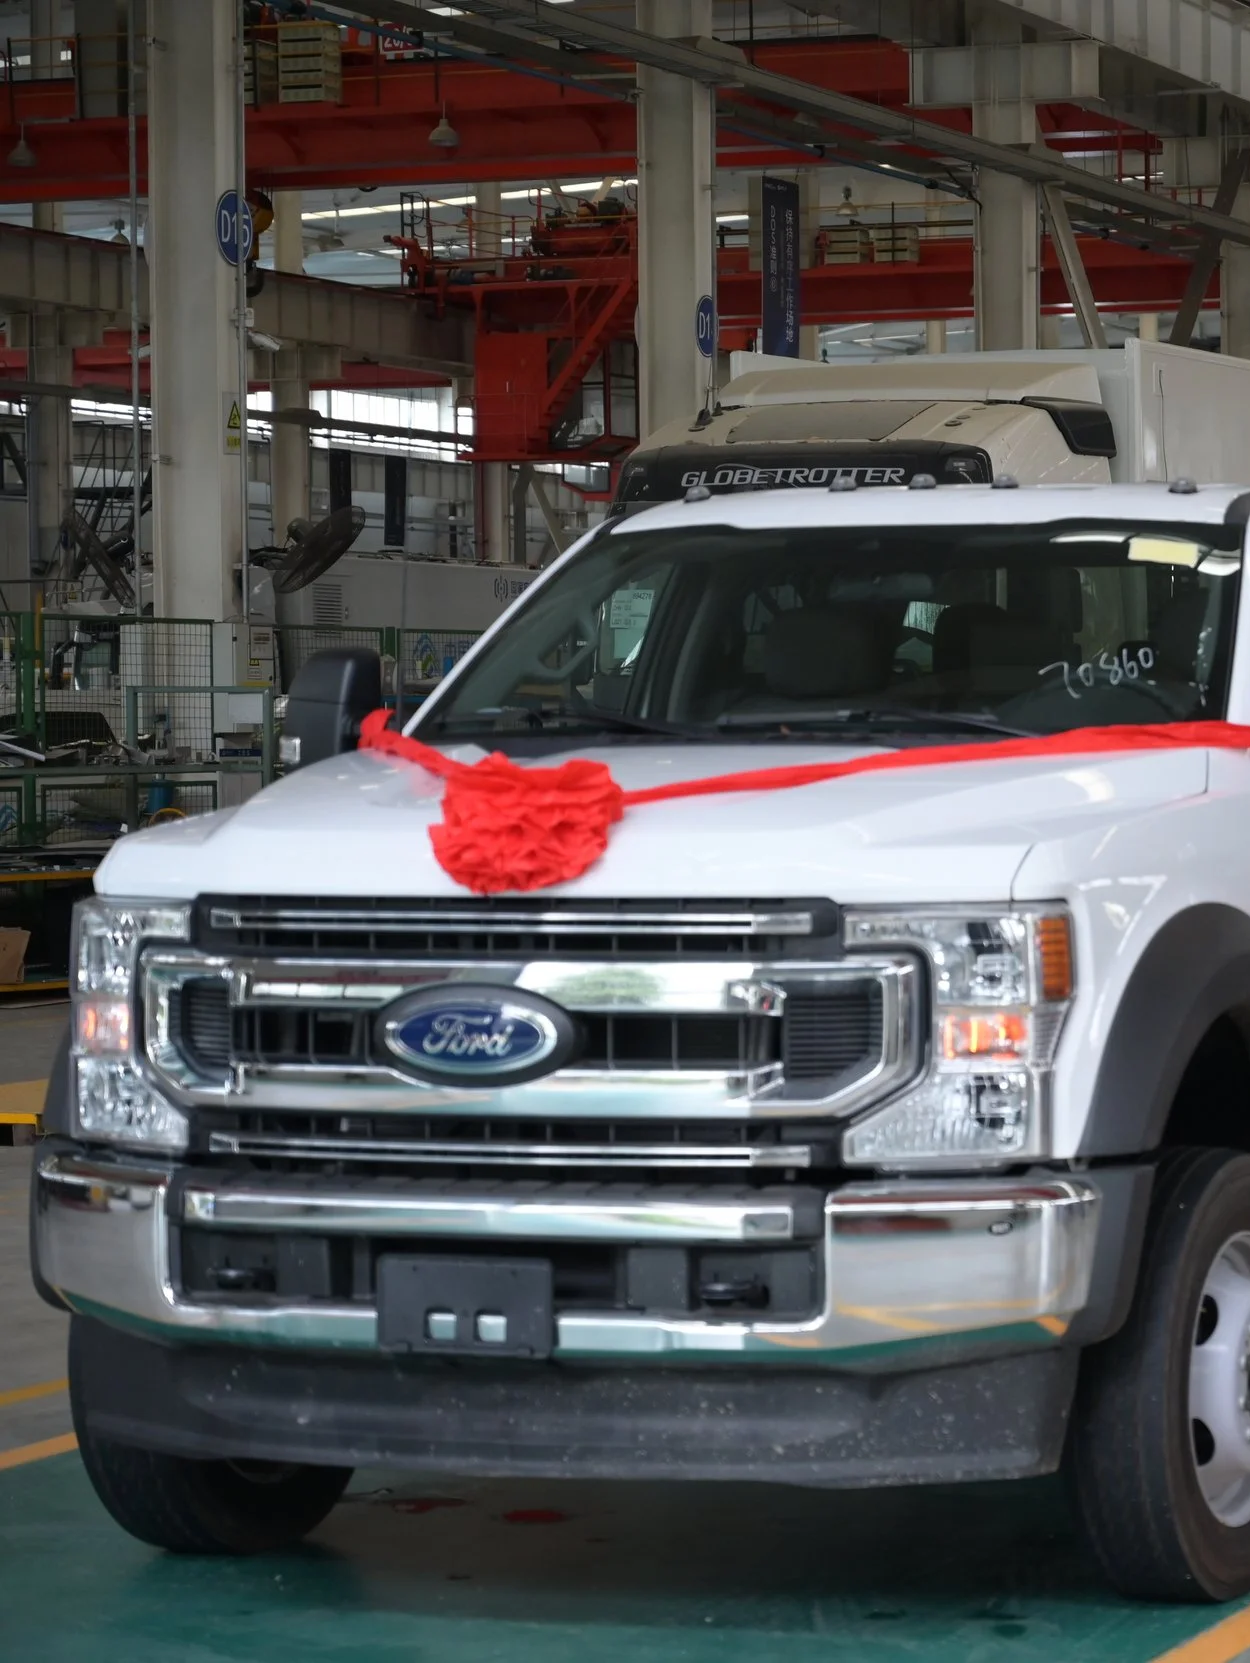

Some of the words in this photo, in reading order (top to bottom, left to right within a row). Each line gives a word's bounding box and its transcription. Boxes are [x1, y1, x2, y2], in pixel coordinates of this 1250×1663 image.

[221, 209, 250, 248] D15
[681, 467, 905, 487] GLOBETROTTER
[1038, 647, 1154, 699] 70860
[423, 1014, 515, 1056] Ford
